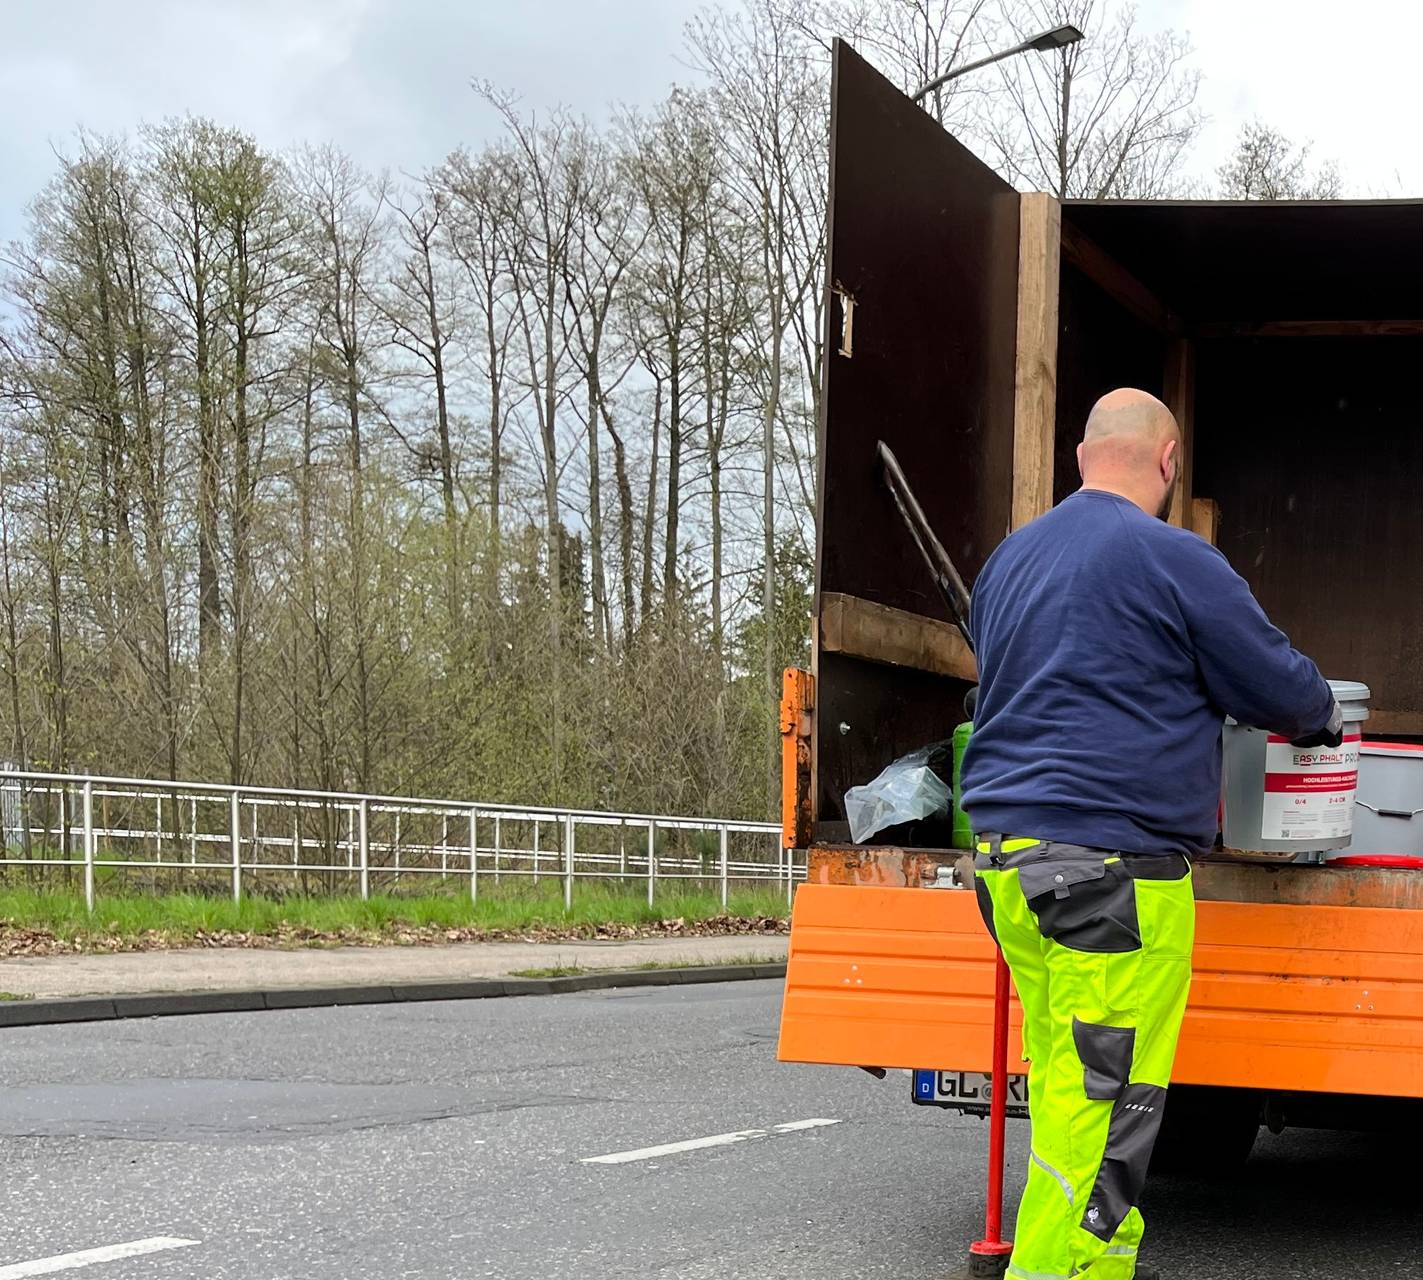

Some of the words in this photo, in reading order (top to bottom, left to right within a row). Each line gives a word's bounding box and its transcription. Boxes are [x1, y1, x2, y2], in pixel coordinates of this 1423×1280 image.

[1293, 754, 1317, 765] EASY
[1320, 753, 1343, 763] PHALT
[922, 1083, 930, 1093] D
[937, 1071, 978, 1098] GL
